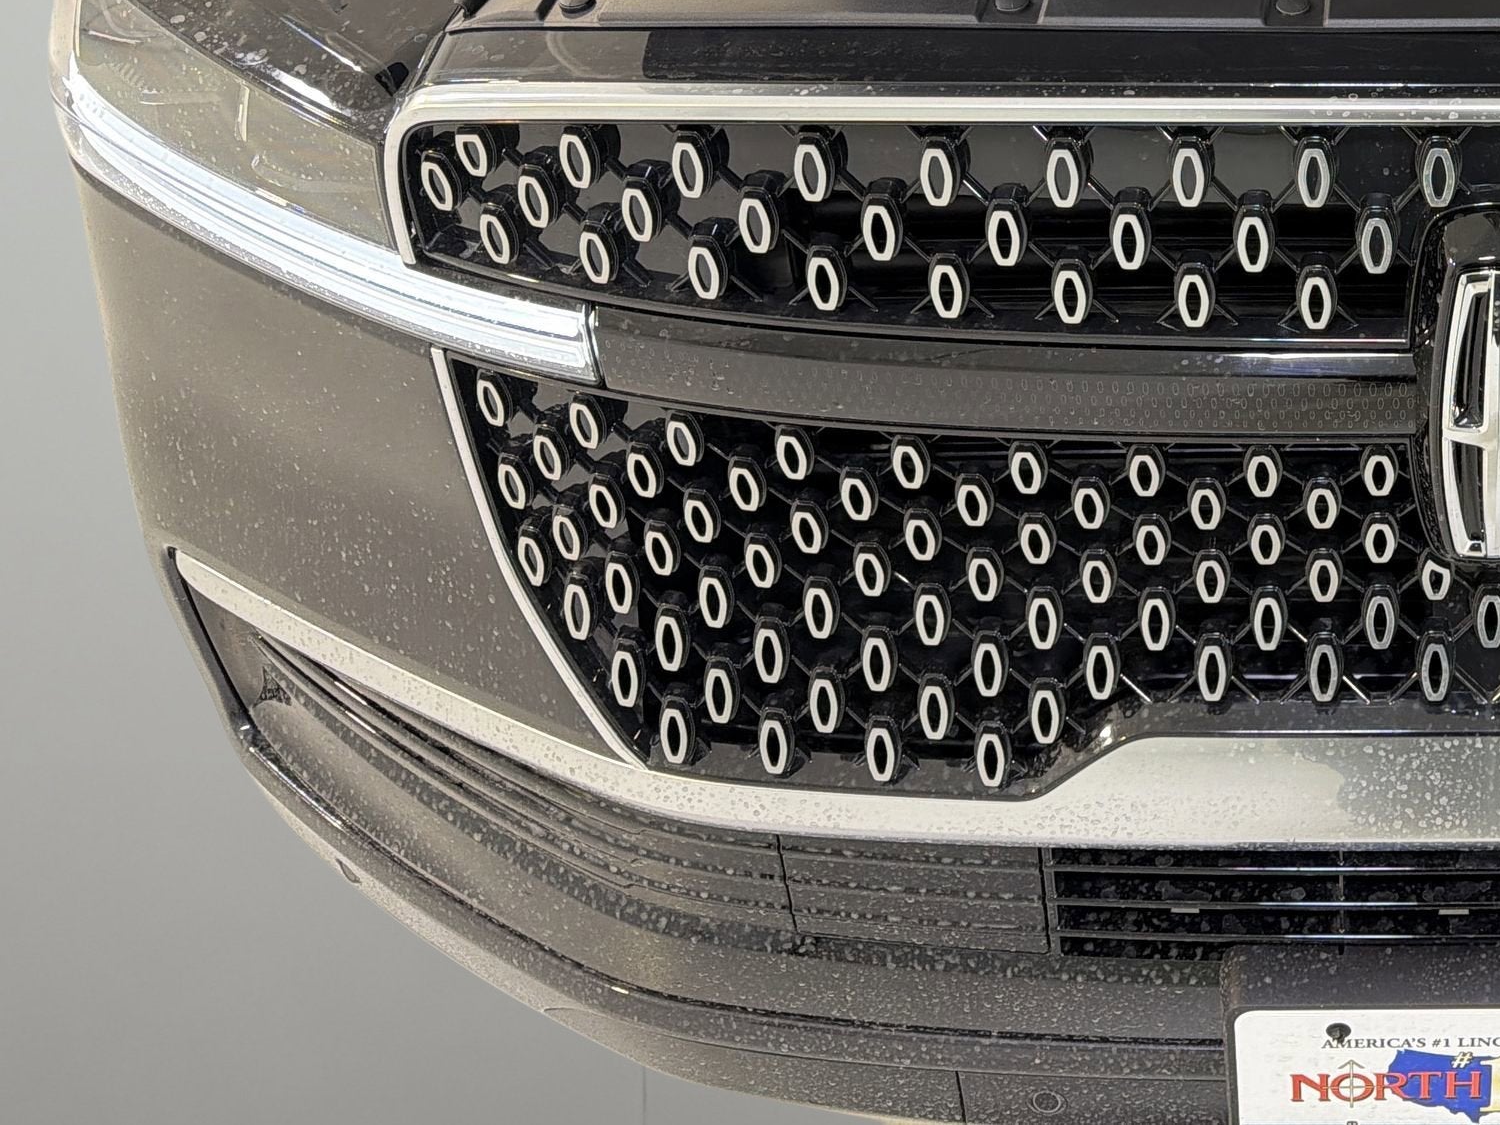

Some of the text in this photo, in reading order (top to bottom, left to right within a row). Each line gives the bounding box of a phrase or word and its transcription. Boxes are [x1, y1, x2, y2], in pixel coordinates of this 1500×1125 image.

[1320, 1038, 1427, 1049] AMERICA'S
[1431, 1037, 1451, 1048] #1
[1290, 1070, 1481, 1103] NORTH
